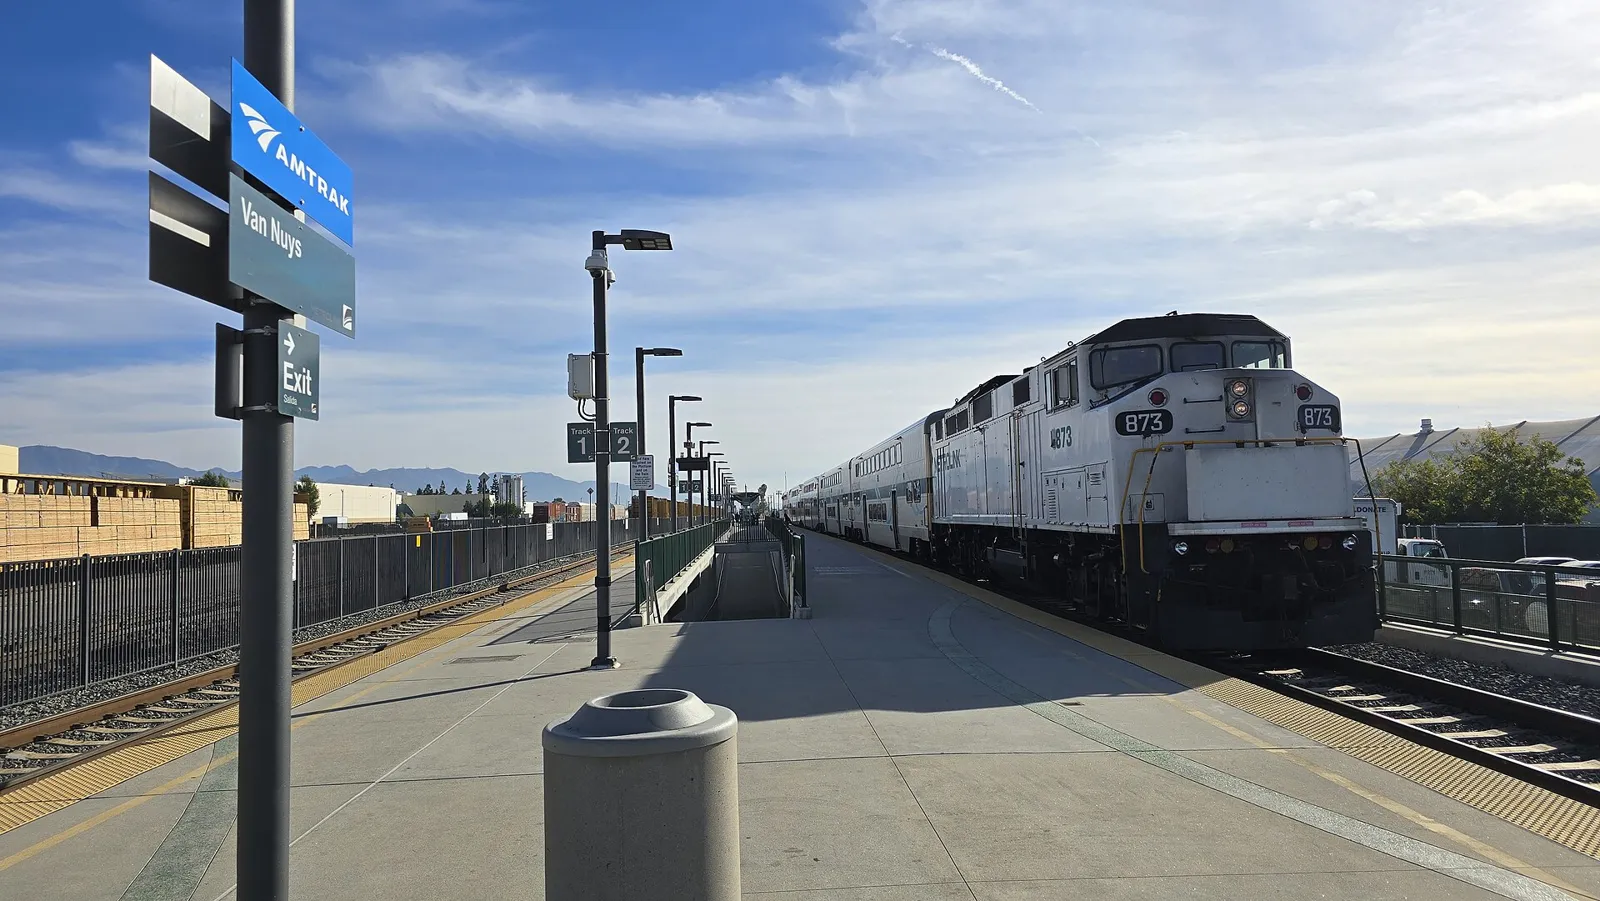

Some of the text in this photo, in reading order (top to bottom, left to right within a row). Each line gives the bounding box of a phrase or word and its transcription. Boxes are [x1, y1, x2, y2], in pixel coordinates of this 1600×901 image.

[275, 143, 350, 216] AMTRAK
[241, 196, 302, 259] Van Nuys
[283, 360, 313, 397] Exit
[283, 393, 298, 406] Salida
[1125, 412, 1163, 433] 873
[1303, 407, 1332, 426] 873
[571, 427, 592, 435] Track
[613, 427, 634, 435] Track
[577, 436, 586, 455] 1
[617, 436, 631, 454] 2
